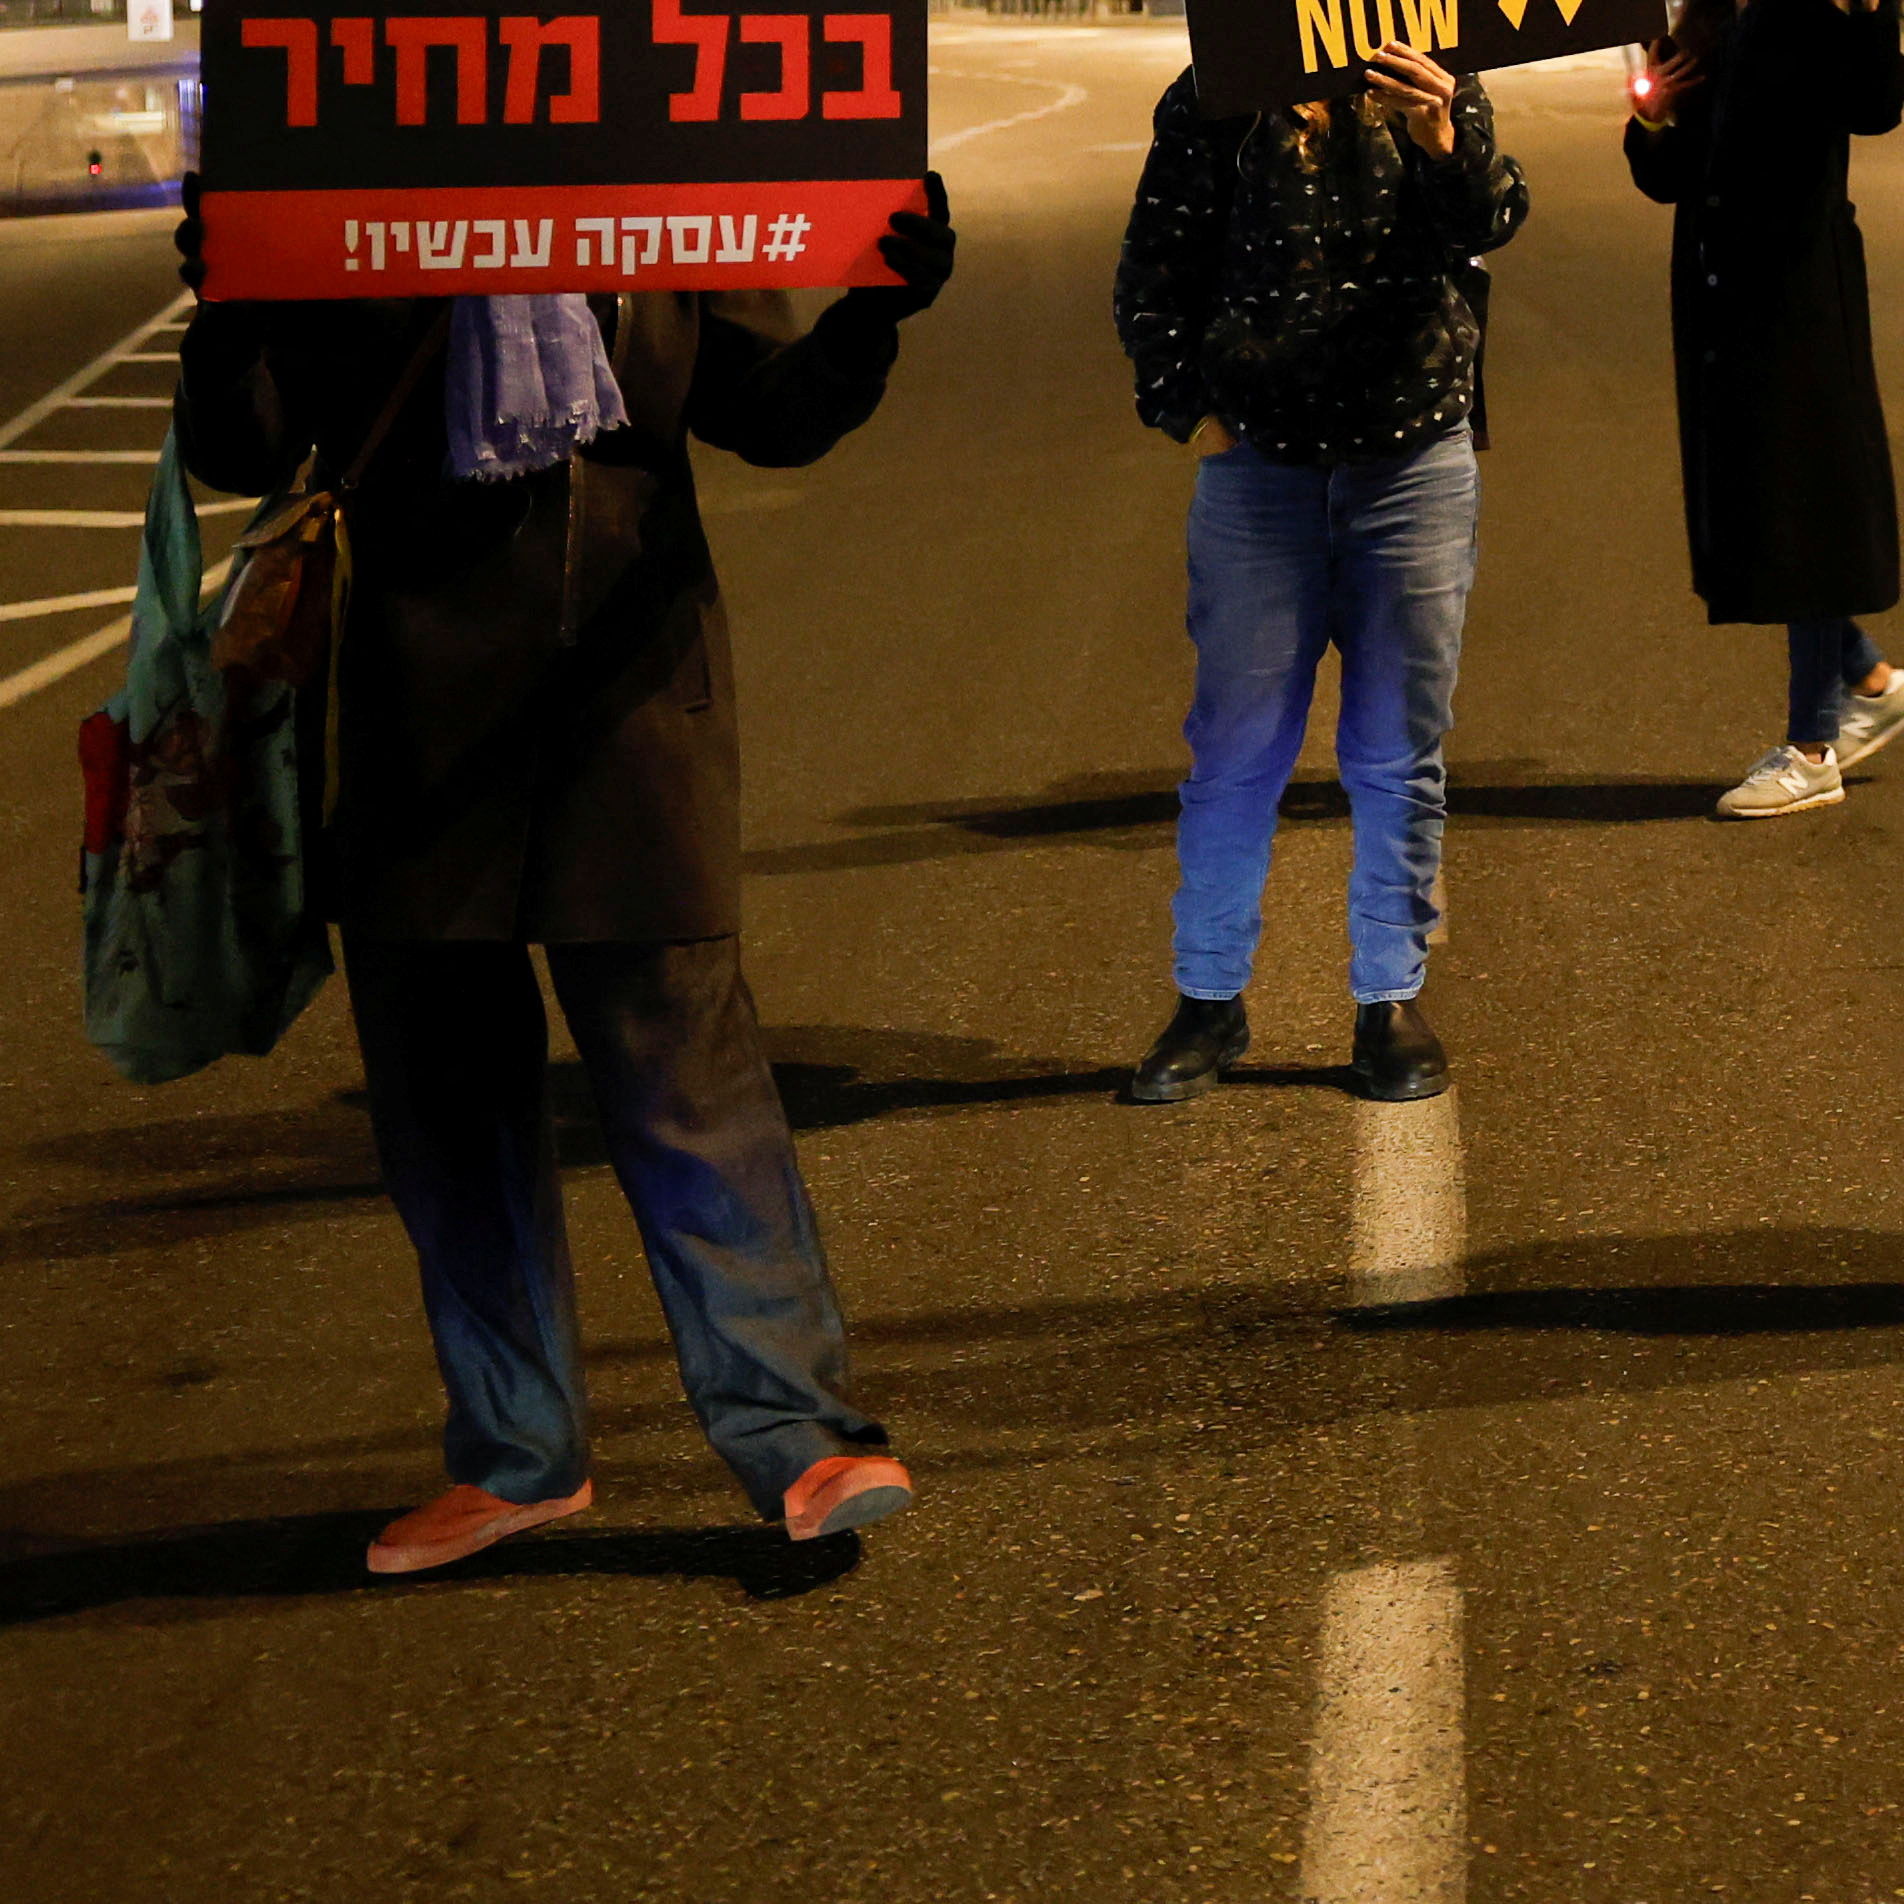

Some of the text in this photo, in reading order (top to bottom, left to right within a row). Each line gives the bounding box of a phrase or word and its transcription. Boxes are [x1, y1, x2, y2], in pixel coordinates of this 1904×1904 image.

[241, 15, 602, 127] מחיר
[345, 213, 812, 276] #עסקה עכשיו!
